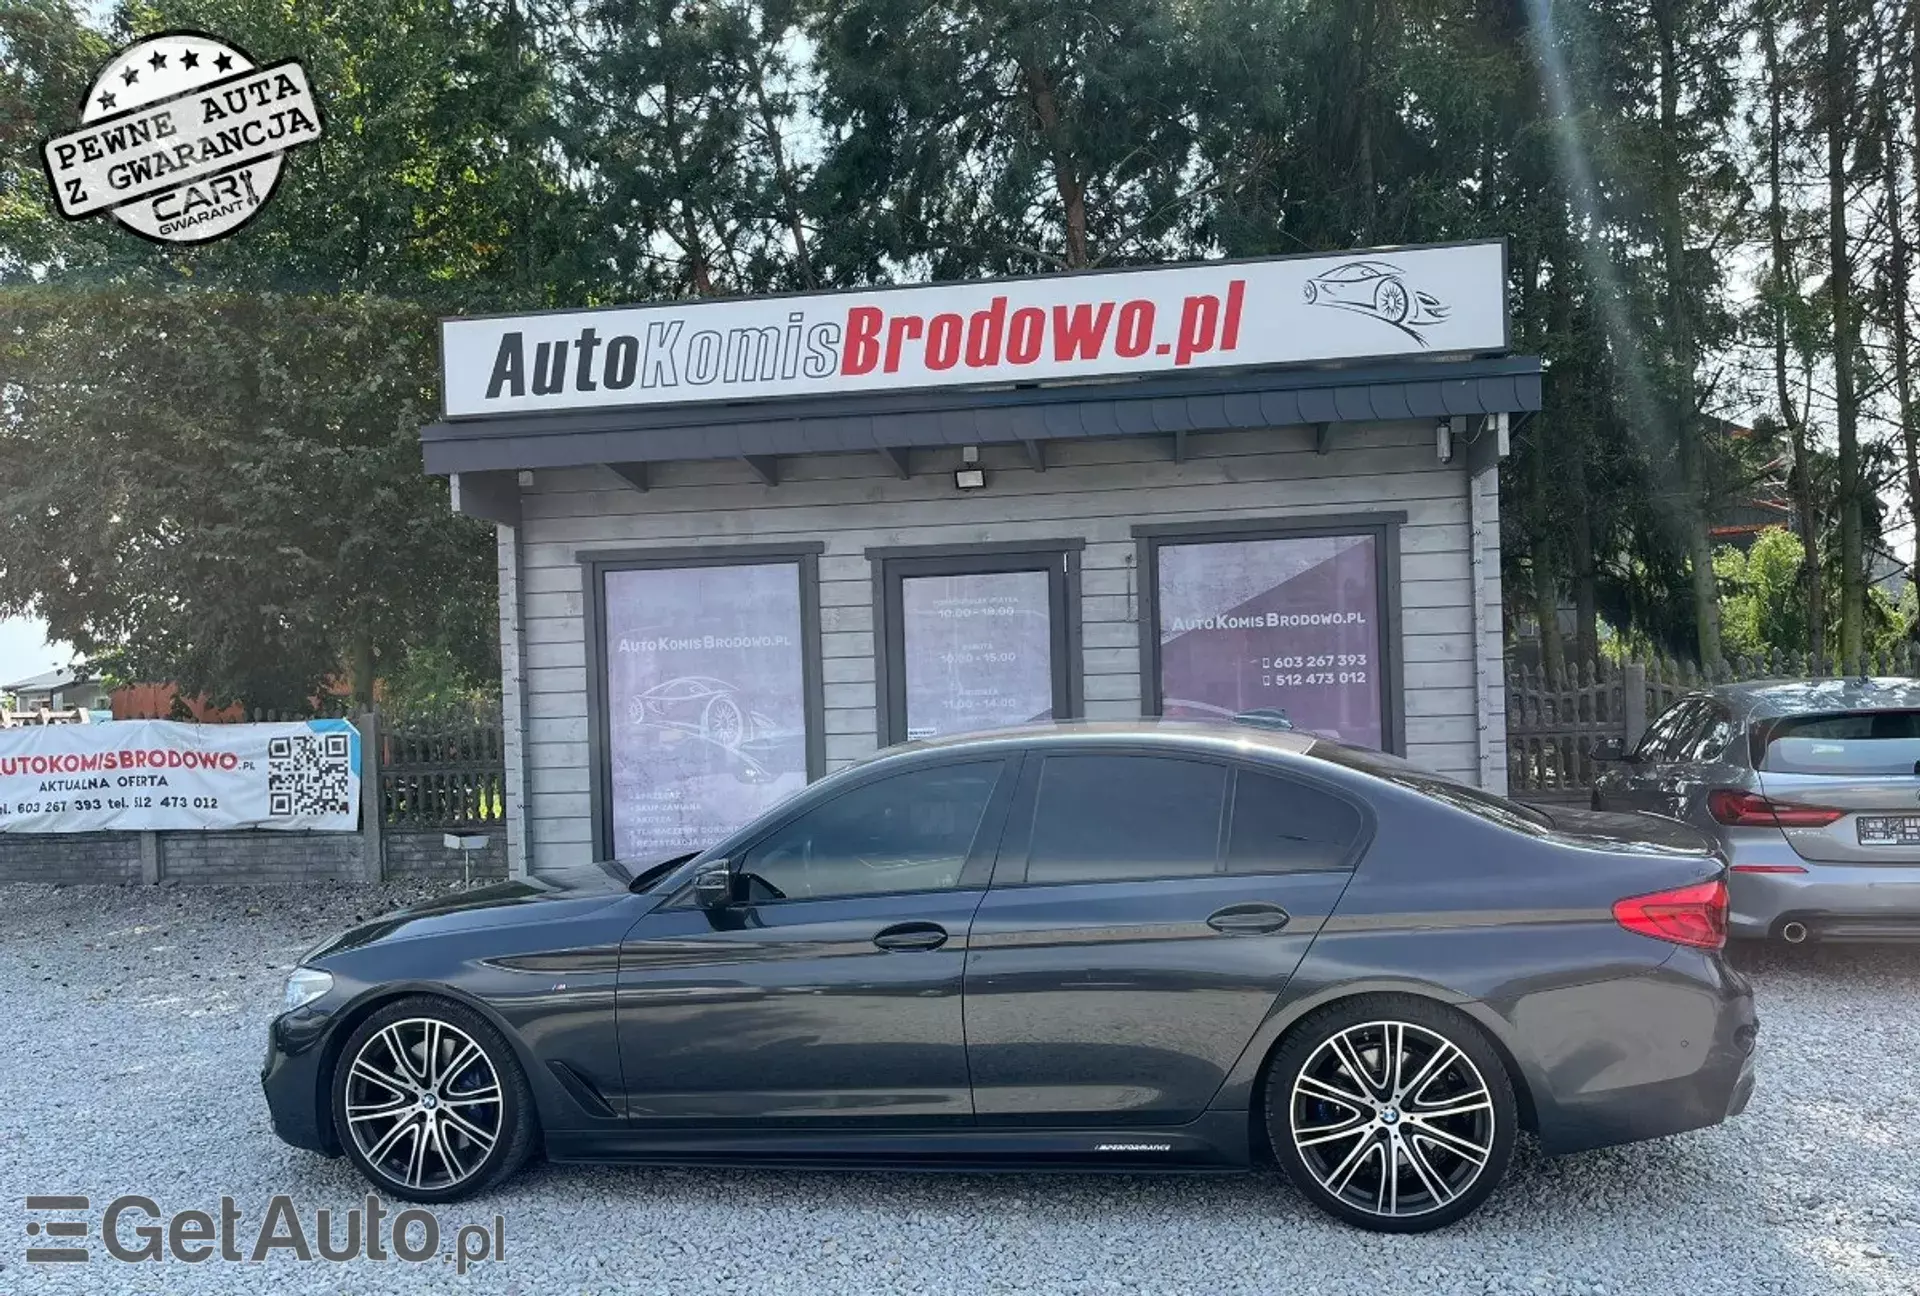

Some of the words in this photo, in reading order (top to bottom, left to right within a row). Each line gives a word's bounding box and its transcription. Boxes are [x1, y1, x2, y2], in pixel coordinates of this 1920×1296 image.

[486, 279, 1246, 399] AutoKomisBrodowo.pl
[984, 652, 1016, 662] 15.00
[1274, 657, 1304, 669] 603
[1306, 656, 1334, 668] 267
[1337, 654, 1367, 667] 393
[1276, 674, 1302, 686] 512
[1306, 673, 1335, 685] 473
[1339, 671, 1366, 684] 012
[0, 750, 256, 776] UTOKOMISBRODOWO.PL
[39, 777, 110, 793] AKTUALNA
[117, 775, 168, 788] OFERTA
[18, 802, 40, 814] 603
[45, 801, 67, 813] 267
[75, 799, 102, 811] 393
[108, 796, 129, 809] tel.
[134, 796, 152, 808] 512
[160, 796, 188, 808] 473
[193, 797, 218, 809] 012
